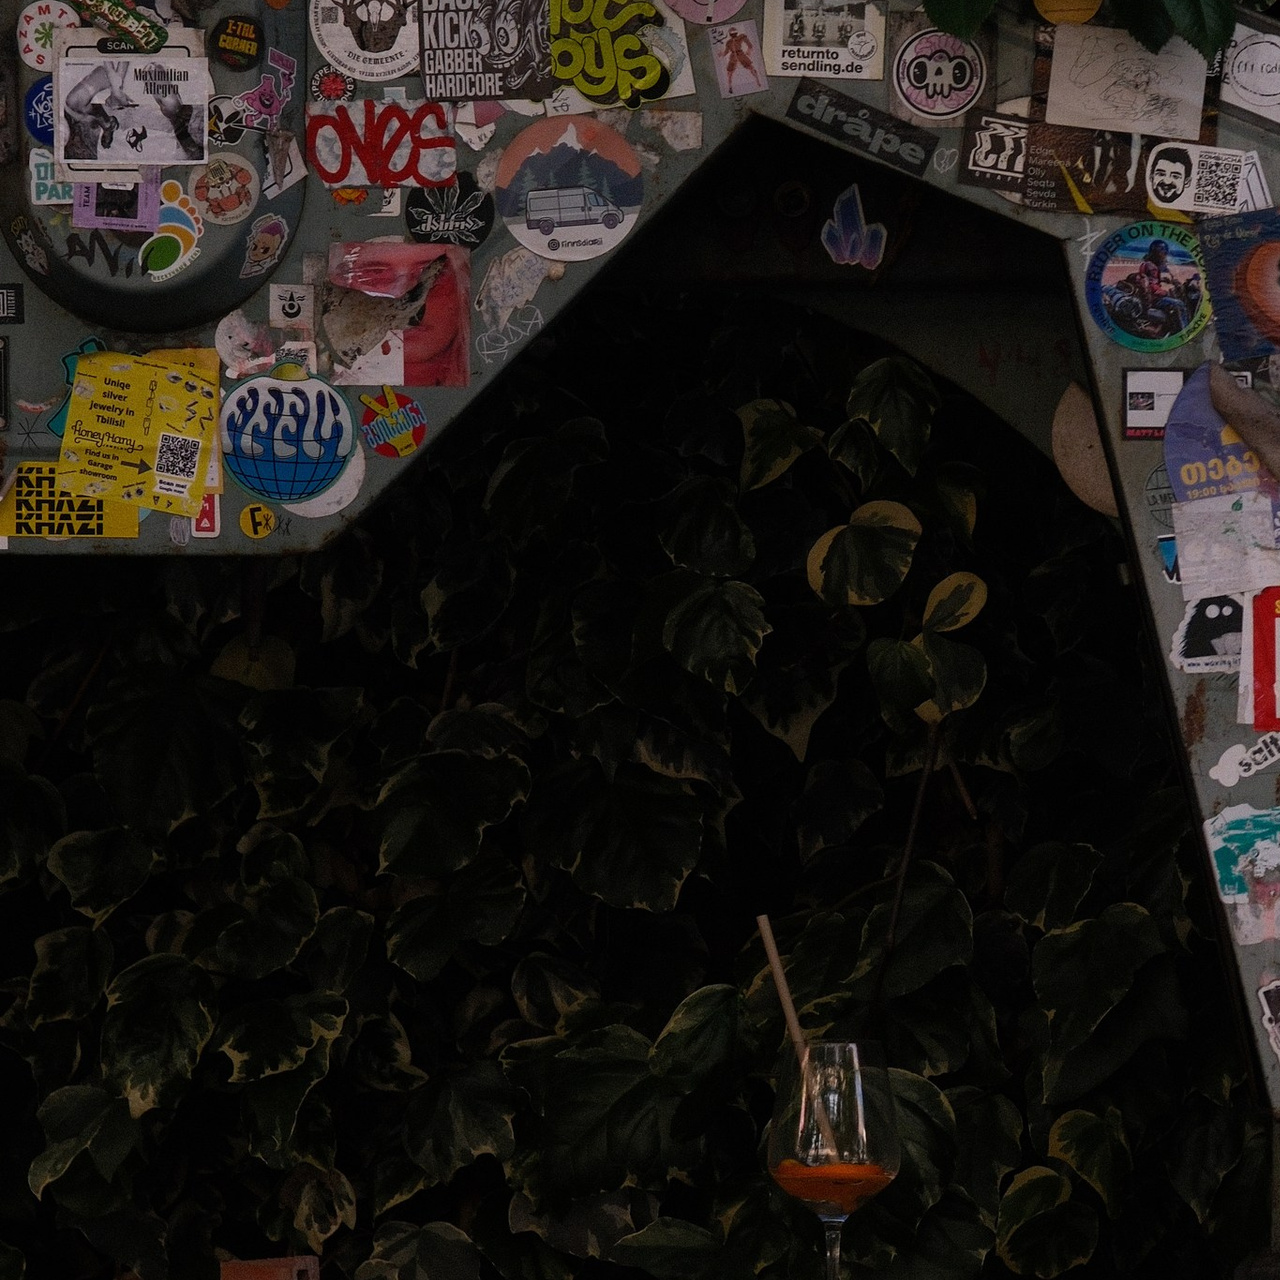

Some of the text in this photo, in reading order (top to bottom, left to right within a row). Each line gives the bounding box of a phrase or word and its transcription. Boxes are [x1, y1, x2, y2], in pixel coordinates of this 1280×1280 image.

[424, 12, 474, 49] KICK
[781, 48, 839, 60] returnto
[425, 49, 483, 74] GABBER
[781, 61, 863, 74] sendling.de
[133, 69, 189, 81] Maximilian
[143, 82, 178, 97] Allegro
[425, 74, 504, 97] HARDCORE
[797, 94, 926, 165] dråpe
[1199, 154, 1242, 165] KOMBUCHA
[1128, 223, 1154, 238] ON
[1160, 223, 1194, 248] THE
[103, 377, 131, 390] Uniqe
[102, 390, 128, 402] silver
[89, 401, 135, 416] jewelry in
[96, 414, 126, 428] Tbilisi!
[85, 448, 120, 461] Find us in
[87, 459, 113, 471] Garage
[79, 468, 118, 481] showroom
[15, 513, 103, 535] KHAZI
